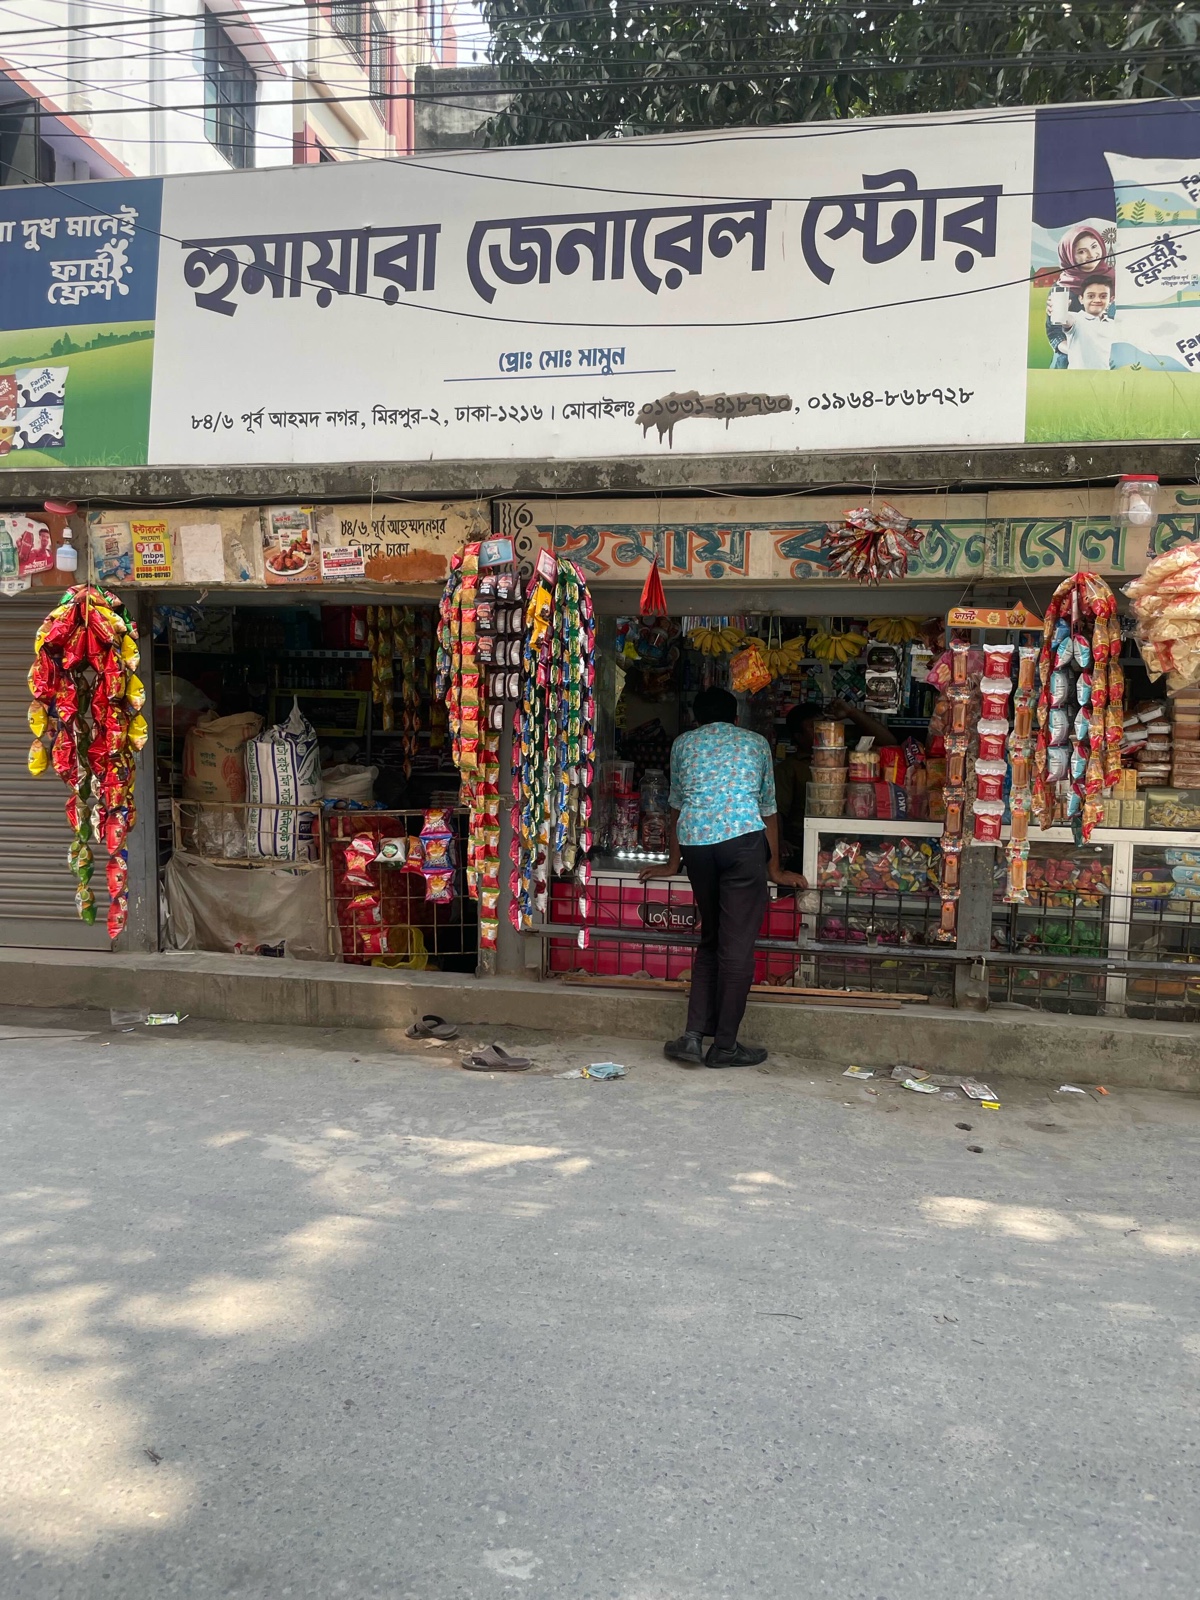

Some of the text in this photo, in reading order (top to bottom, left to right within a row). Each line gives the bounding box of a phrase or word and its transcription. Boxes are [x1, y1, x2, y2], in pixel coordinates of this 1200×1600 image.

[21, 217, 60, 252] দুধ
[65, 204, 139, 237] মানেই
[182, 168, 1004, 317] হুমায়ারা জেনারেল স্টোর
[50, 252, 112, 282] ফার্ম
[1125, 244, 1169, 275] ফার্ম
[1134, 256, 1179, 288] ফ্রেশ
[47, 279, 115, 306] ফ্রেশ
[499, 346, 626, 376] প্রোঃ মোঃ মামুন
[30, 374, 48, 388] Farm
[33, 379, 52, 394] Fresh
[191, 411, 234, 433] ৮৪/৬
[240, 406, 266, 434] পূর্ব
[267, 410, 322, 429] আহমদ
[325, 408, 367, 430] নগর,
[370, 403, 450, 428] মিরপুর-২,
[454, 404, 544, 424] ঢাকা-১২১৬
[562, 396, 636, 420] মোবাইলঃ
[807, 387, 975, 411] ০১৯৬৪-৮৬৮৭২৮
